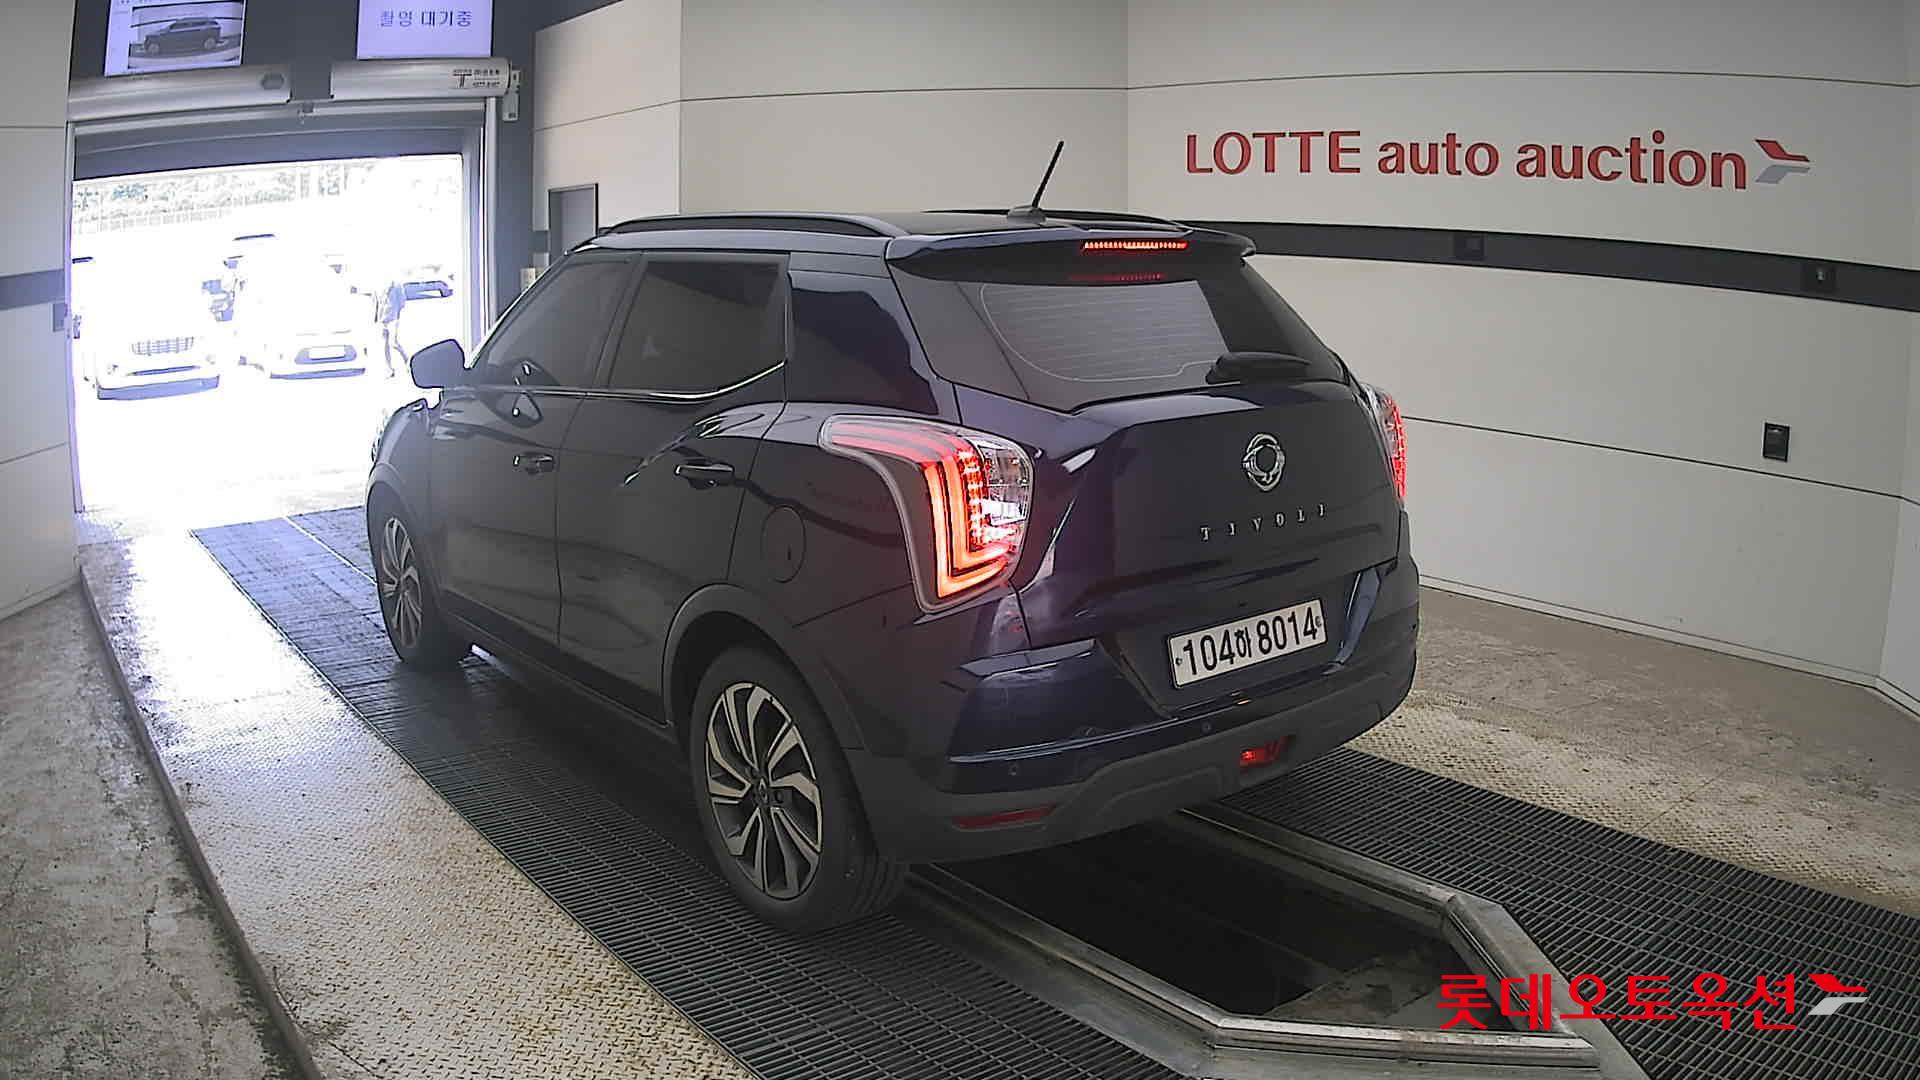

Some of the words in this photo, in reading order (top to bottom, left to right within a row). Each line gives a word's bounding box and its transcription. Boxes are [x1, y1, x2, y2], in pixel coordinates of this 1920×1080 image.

[421, 10, 473, 27] 대기중
[1186, 130, 1361, 174] LOTTE
[1377, 132, 1500, 176] auto
[1516, 129, 1747, 190] auction
[1200, 503, 1326, 541] TIVOLI
[1256, 606, 1317, 655] 8014
